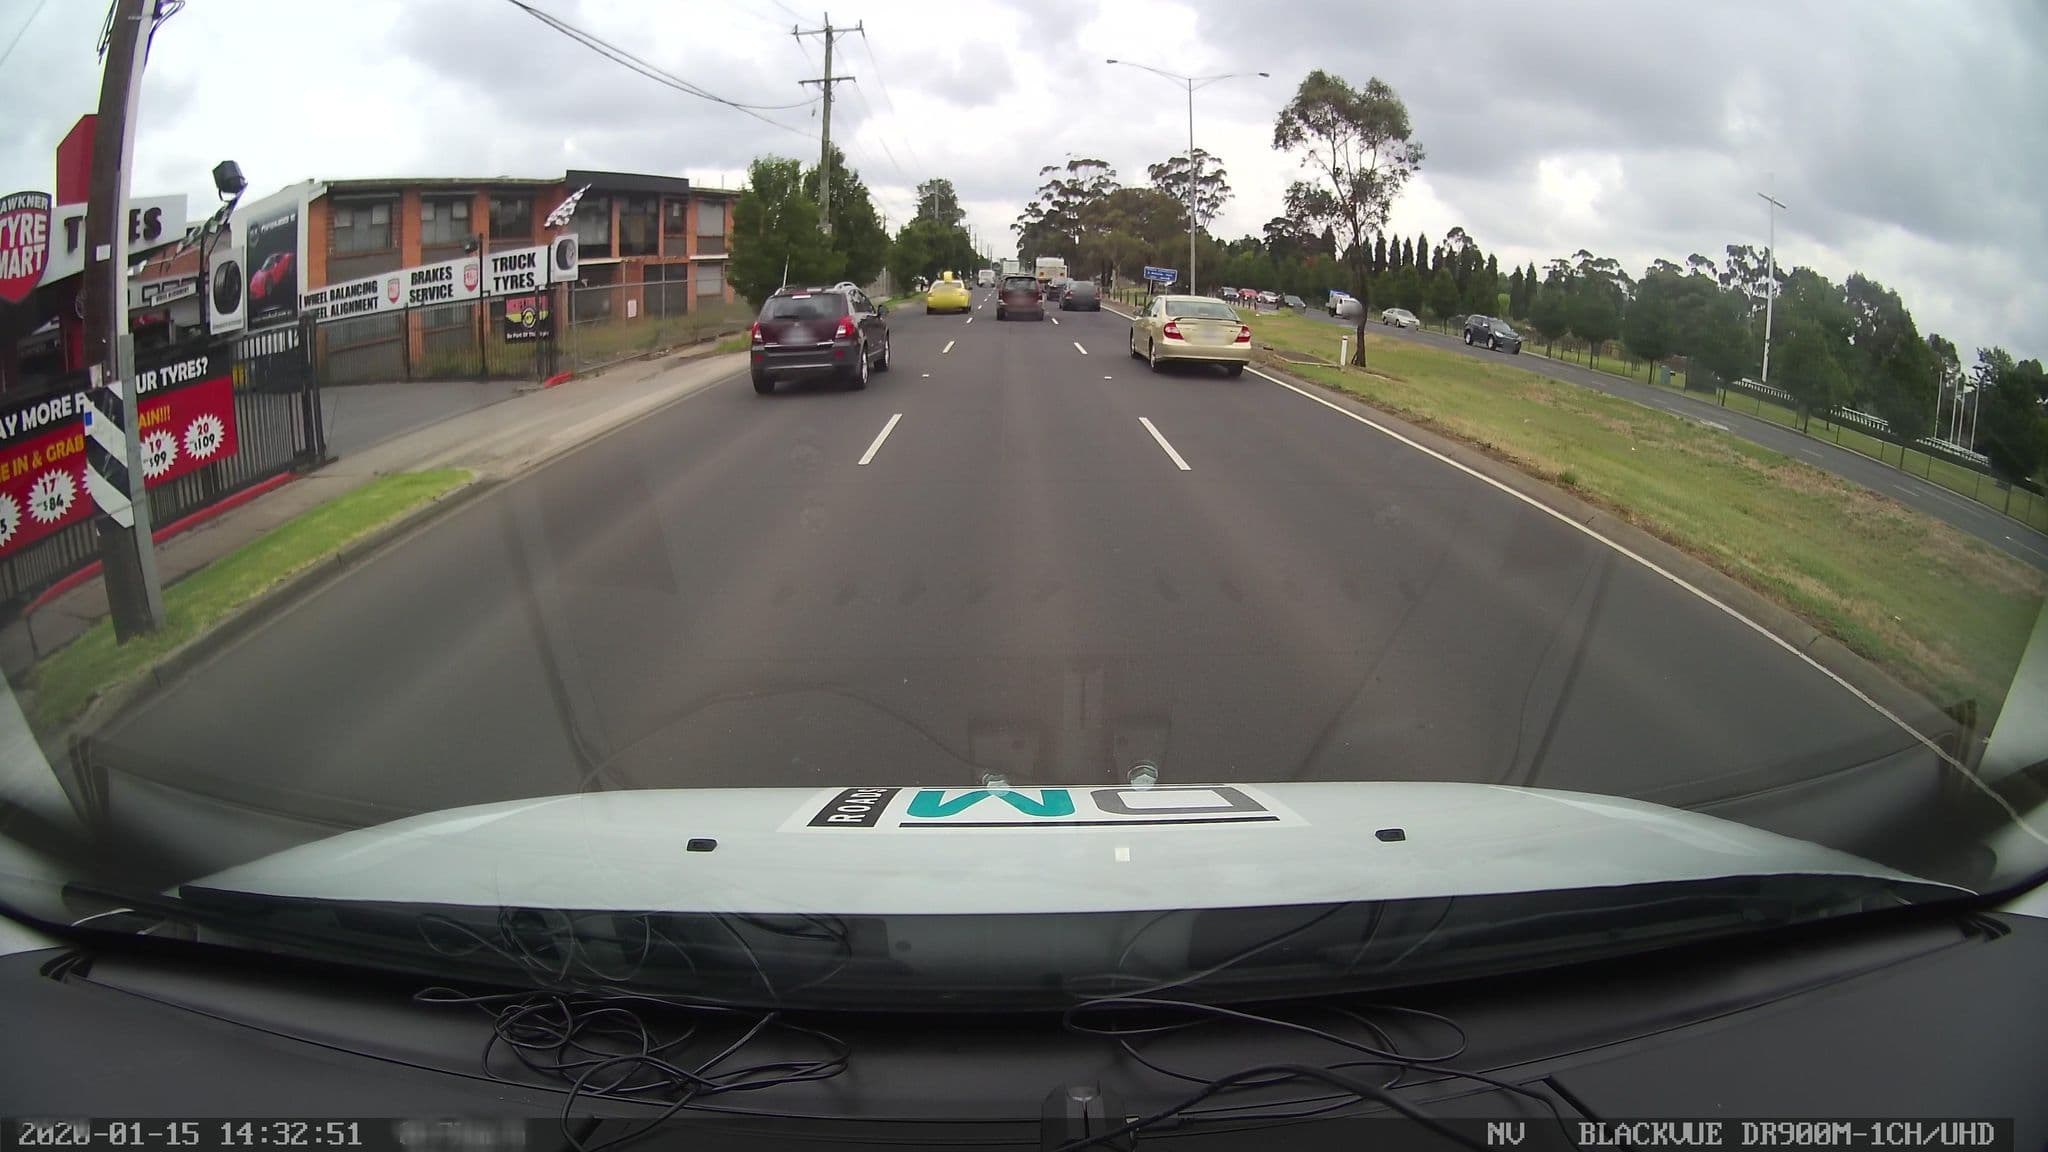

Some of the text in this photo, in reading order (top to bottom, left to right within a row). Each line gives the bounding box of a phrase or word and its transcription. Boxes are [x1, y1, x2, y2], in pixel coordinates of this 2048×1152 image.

[0, 195, 48, 214] AWKNER
[492, 252, 536, 273] TRUCK
[411, 266, 453, 286] BRAKES
[493, 272, 535, 292] TYRES
[330, 280, 378, 301] BALANCING
[409, 284, 454, 303] SERVICE
[330, 296, 379, 317] ALIGNMENT
[135, 371, 157, 394] UR
[160, 356, 208, 386] TYRES?
[0, 413, 17, 439] AY
[22, 395, 72, 432] MORE
[197, 422, 209, 436] 20
[13, 455, 28, 477] IN
[32, 450, 42, 469] &
[46, 434, 84, 462] GRAB
